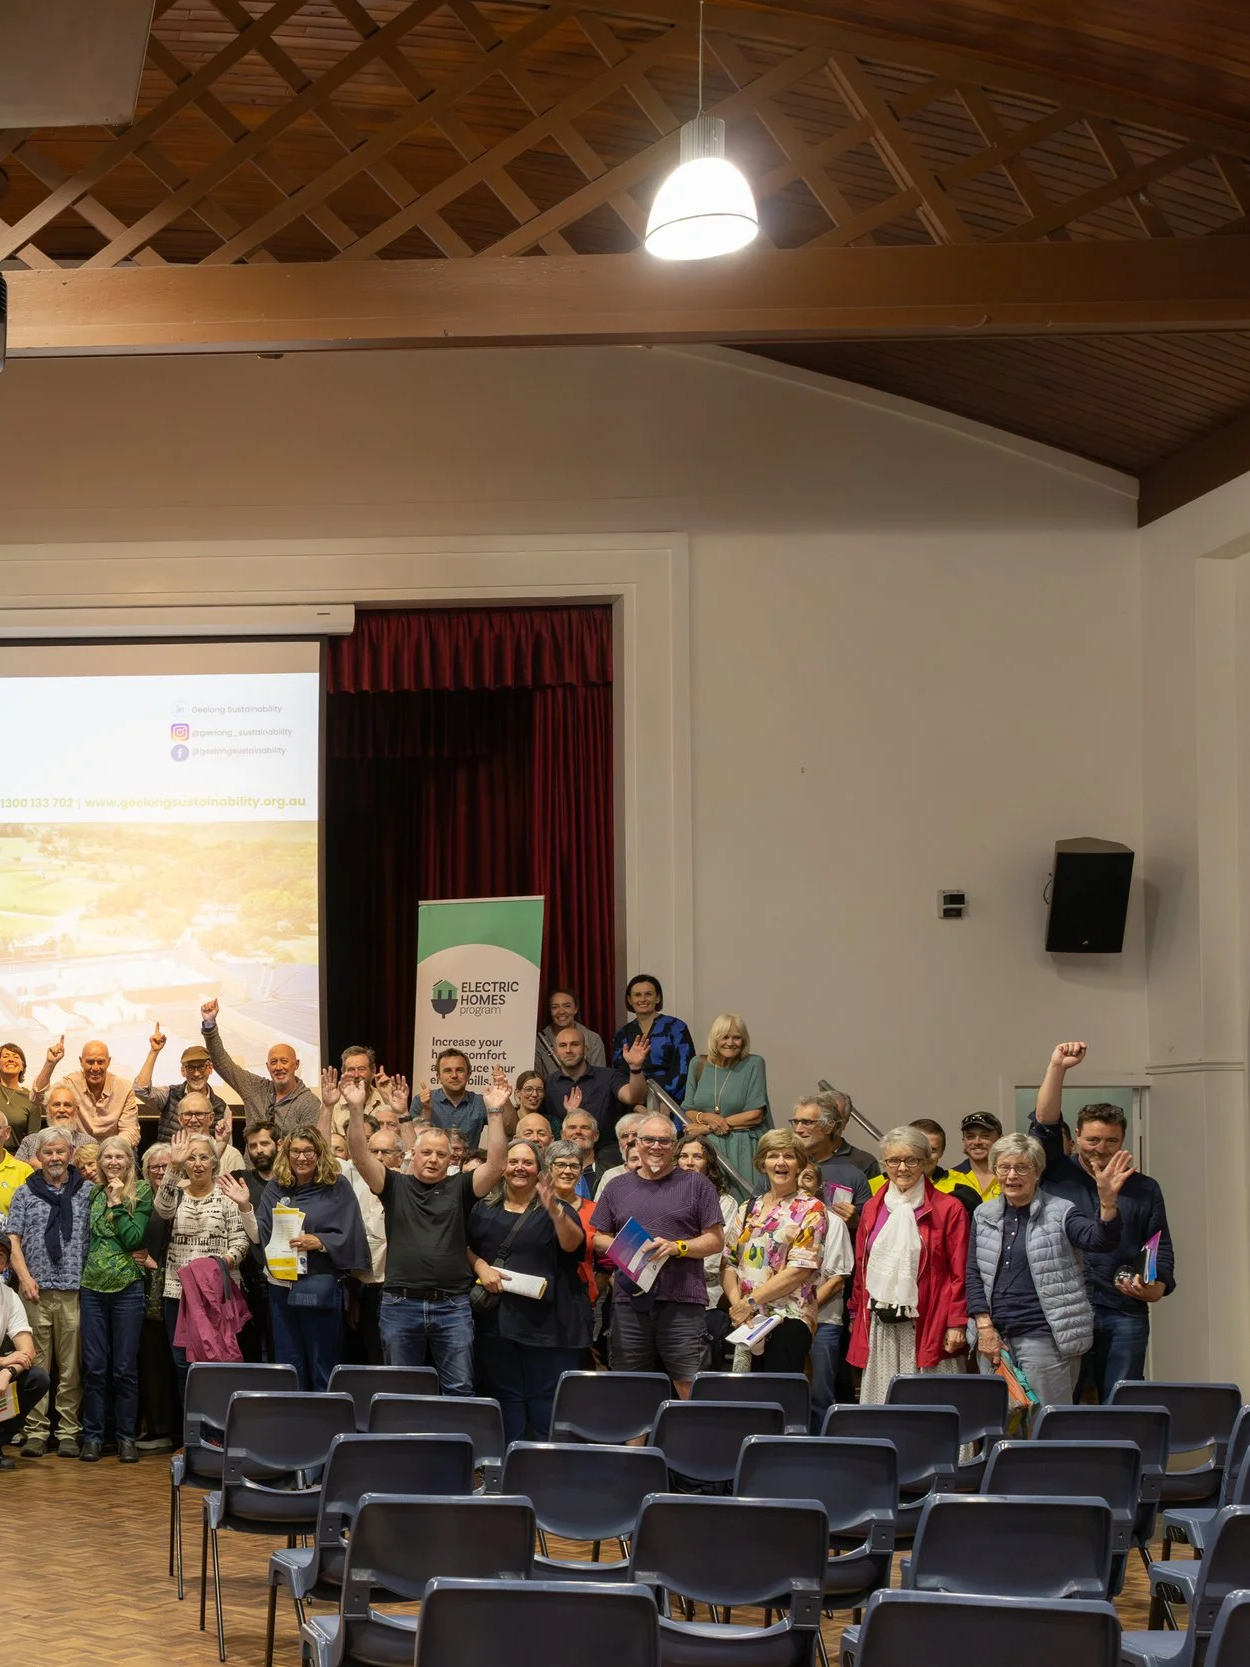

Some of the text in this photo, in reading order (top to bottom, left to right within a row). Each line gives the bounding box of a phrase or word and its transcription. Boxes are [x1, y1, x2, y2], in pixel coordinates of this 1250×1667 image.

[227, 704, 282, 713] Sustainability
[0, 798, 27, 808] 1300
[30, 798, 49, 808] 133
[53, 797, 73, 808] 702
[85, 796, 306, 809] www.geelongsustainability.org.au
[461, 981, 519, 993] ELECTRIC
[460, 994, 506, 1006] HOMES
[459, 1005, 501, 1017] program
[432, 1036, 503, 1050] Increase your
